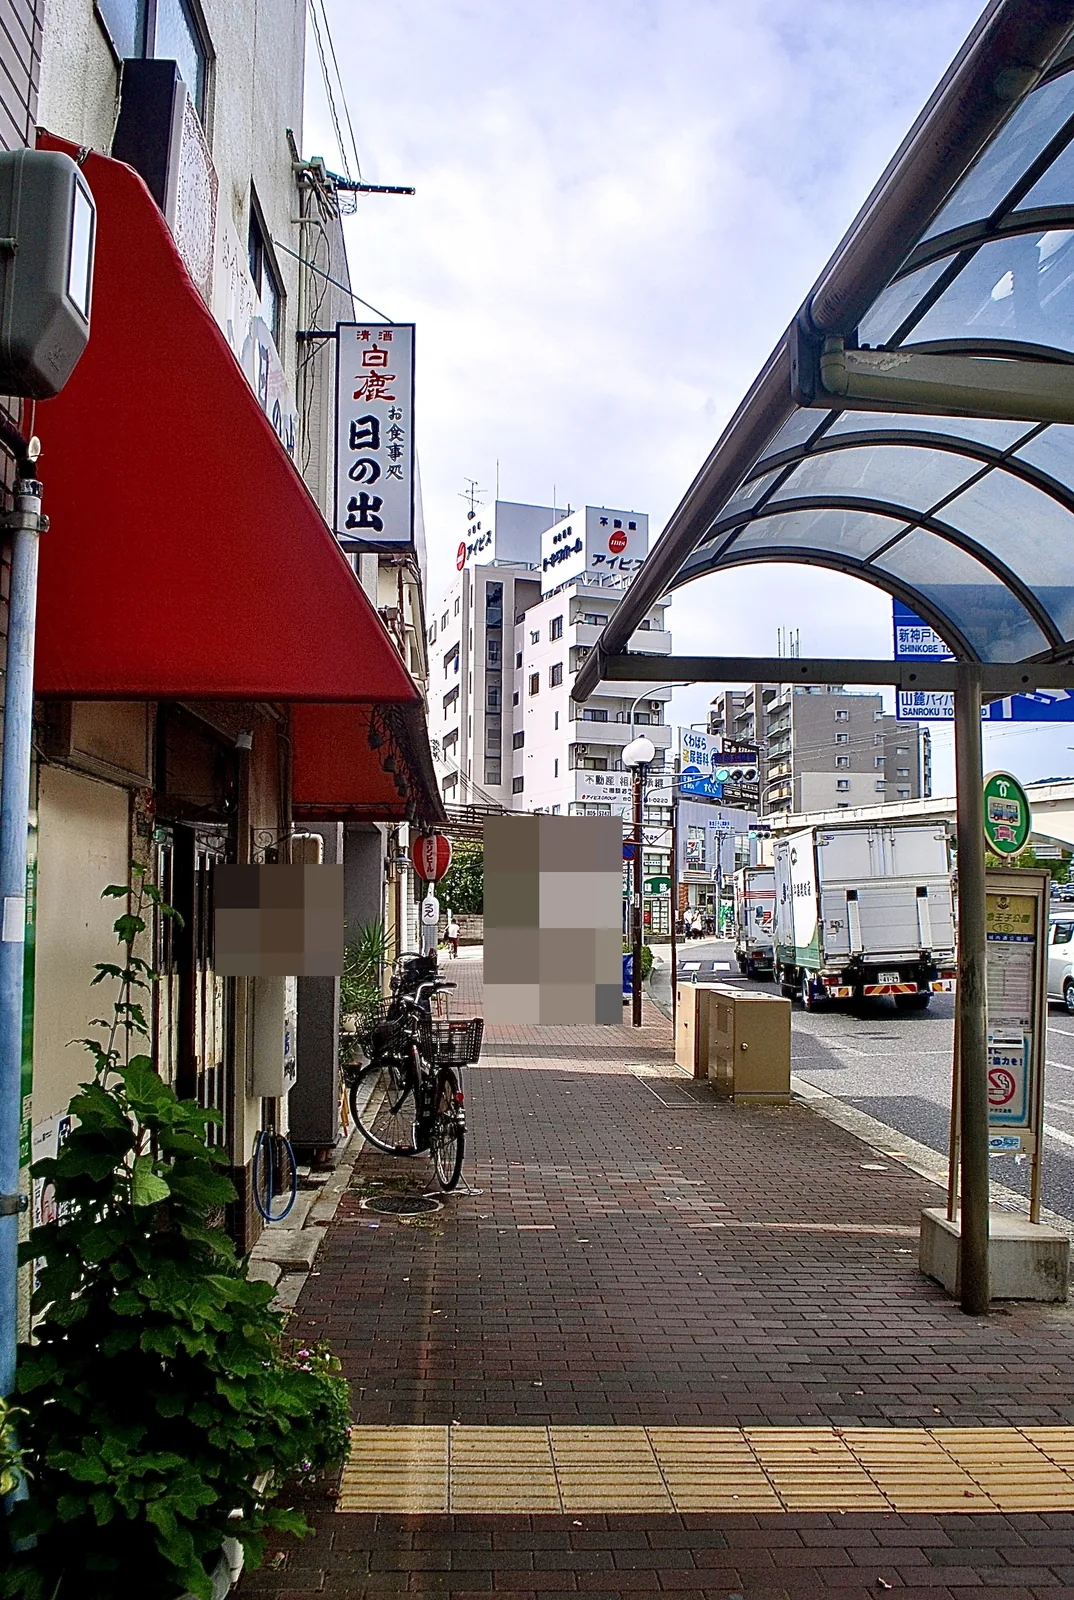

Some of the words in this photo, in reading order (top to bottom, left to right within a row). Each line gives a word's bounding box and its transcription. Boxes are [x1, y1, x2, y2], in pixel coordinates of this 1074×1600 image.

[356, 330, 393, 342] 清酒
[353, 343, 396, 402] 白鹿
[385, 405, 405, 480] お食事処
[345, 414, 384, 532] 日の出
[899, 628, 943, 643] 新神戸ト
[899, 644, 938, 653] SHINKOBE
[902, 707, 940, 716] SANROKU
[584, 774, 615, 786] 不動産
[426, 840, 435, 873] キリンビール
